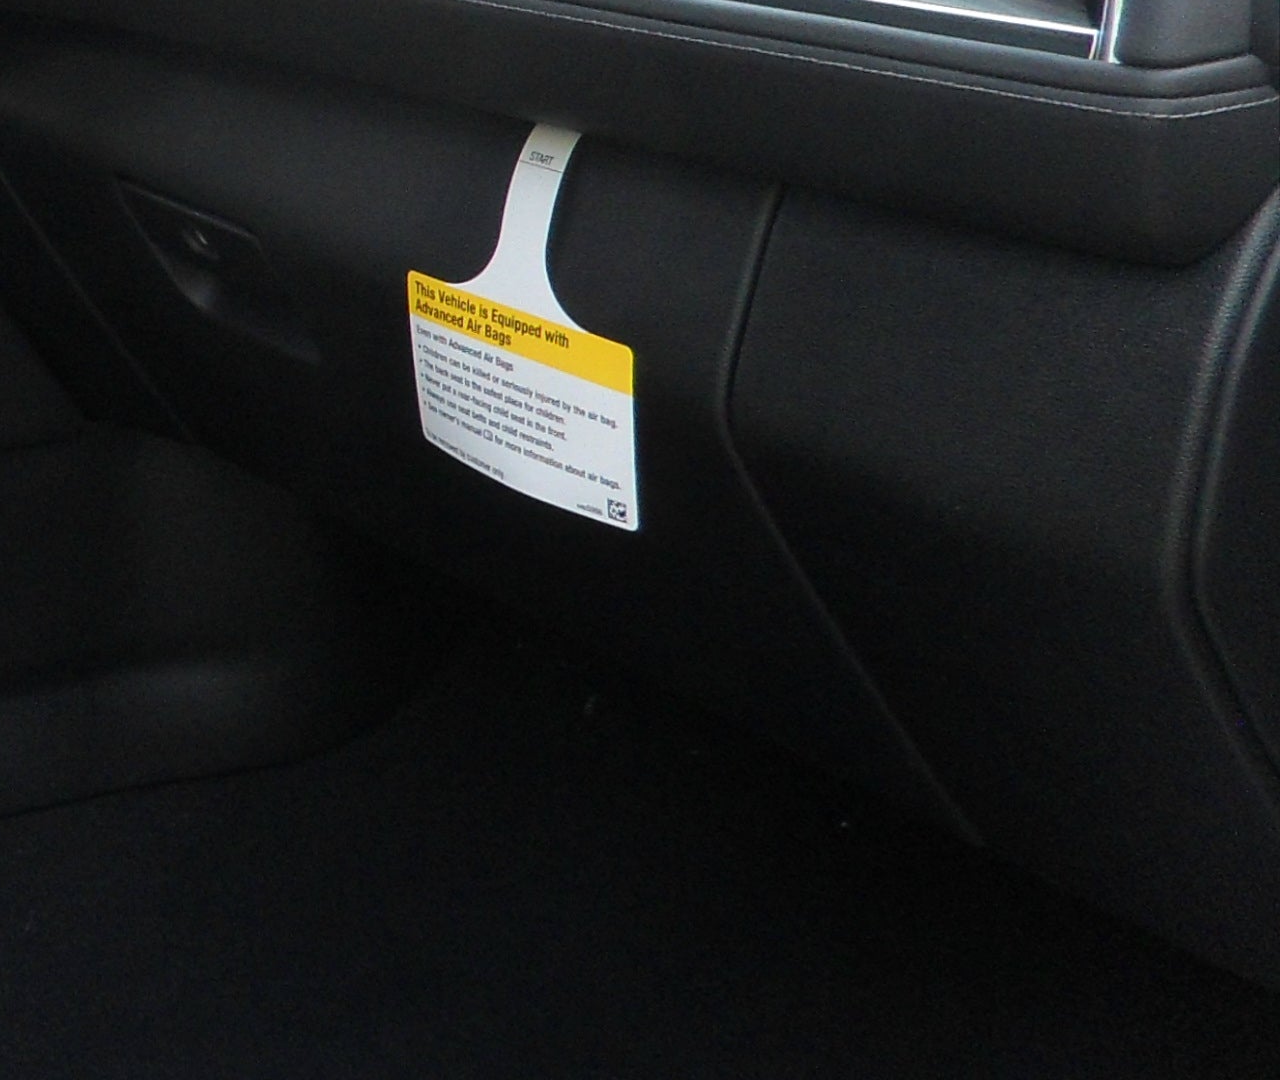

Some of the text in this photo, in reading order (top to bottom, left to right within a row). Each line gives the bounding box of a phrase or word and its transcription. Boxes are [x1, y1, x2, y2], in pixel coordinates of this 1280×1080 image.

[529, 151, 555, 165] START
[415, 281, 570, 349] This Vehicle is Equipped with
[415, 299, 512, 346] Advanced Air Bags
[432, 333, 447, 345] with
[449, 338, 482, 359] Advanced
[483, 352, 494, 363] Air
[495, 356, 514, 372] Bags
[422, 344, 618, 429] Children can be killed or seriously injured by the air bag.
[423, 359, 567, 425] The back seat is the safest place for children.
[425, 373, 441, 387] Never
[441, 383, 452, 394] put
[457, 391, 492, 413] rear-facing
[493, 405, 509, 418] child
[510, 411, 526, 425] seat
[526, 418, 533, 428] in
[535, 421, 546, 433] the
[547, 426, 567, 441] front.
[426, 388, 554, 451] Always use seat belts and child restraints.
[427, 401, 621, 490] See owner's manual for more information about air bags.
[466, 453, 491, 471] customer
